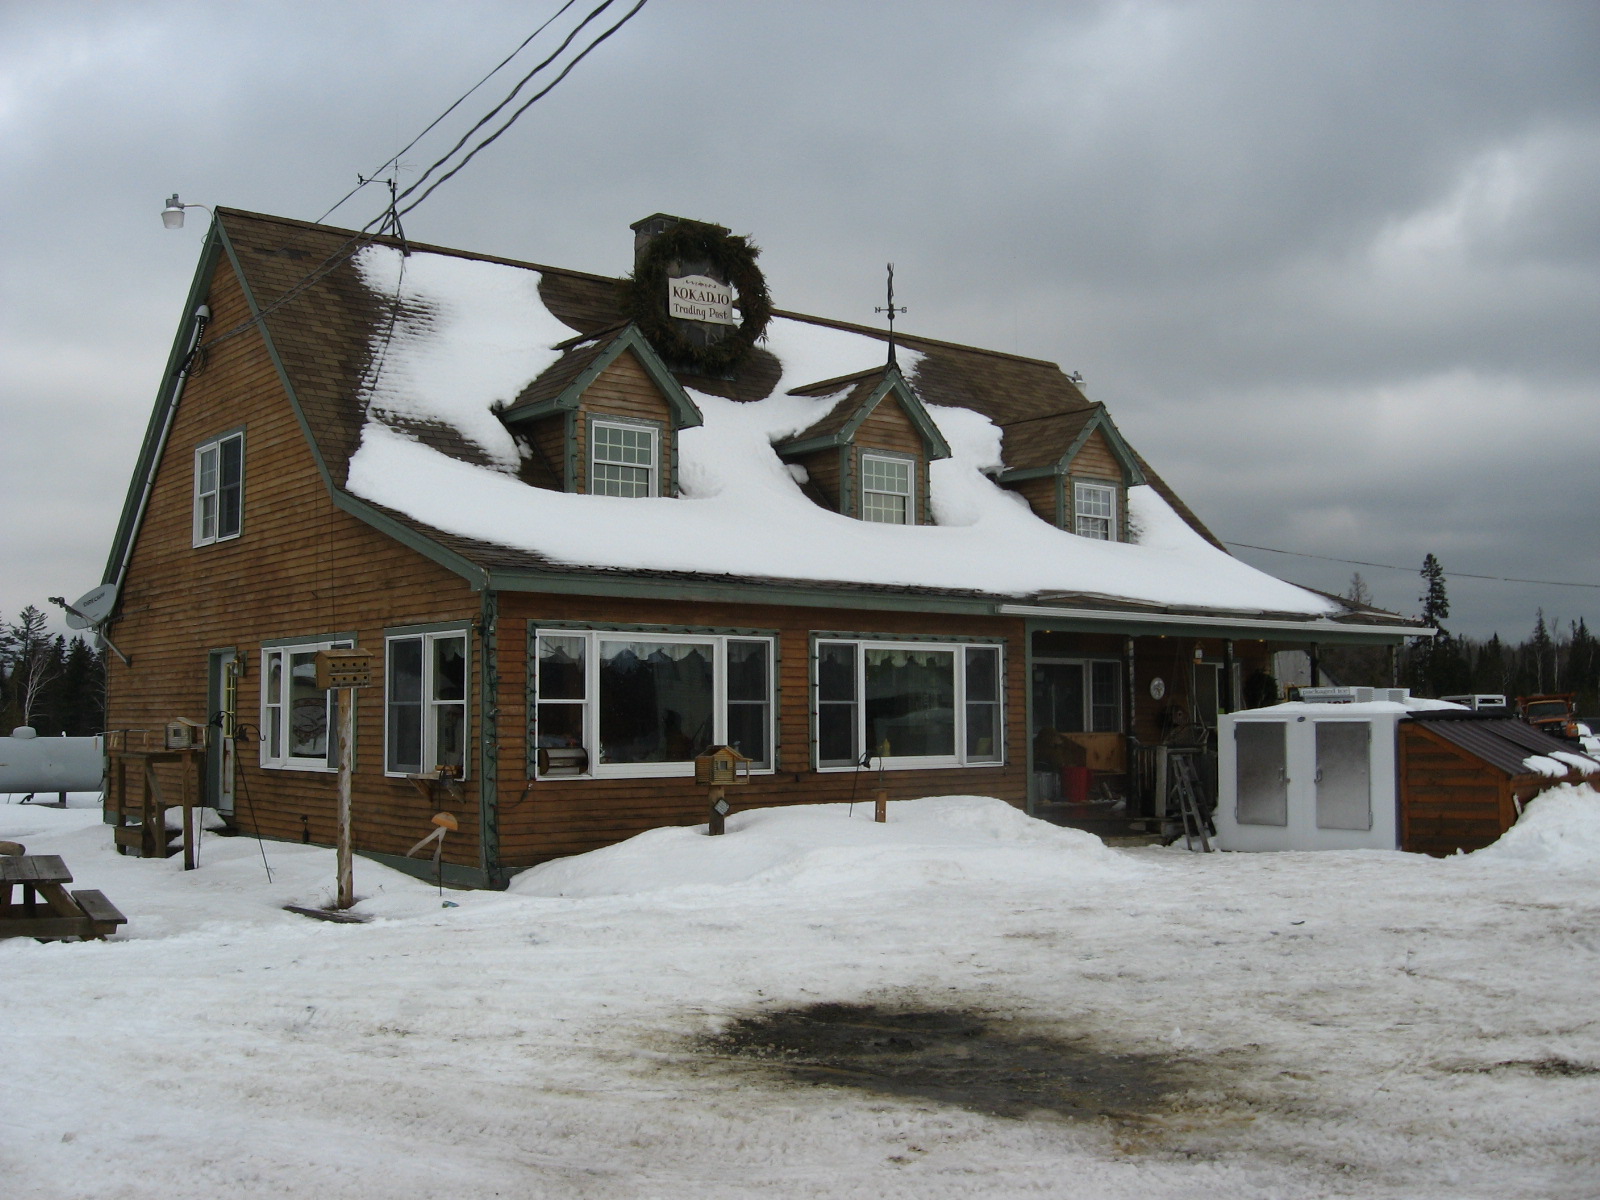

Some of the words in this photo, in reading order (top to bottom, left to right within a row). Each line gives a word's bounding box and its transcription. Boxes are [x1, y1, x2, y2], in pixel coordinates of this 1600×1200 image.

[673, 286, 730, 306] KOKADJO
[674, 303, 706, 320] Trading
[709, 307, 729, 320] Post
